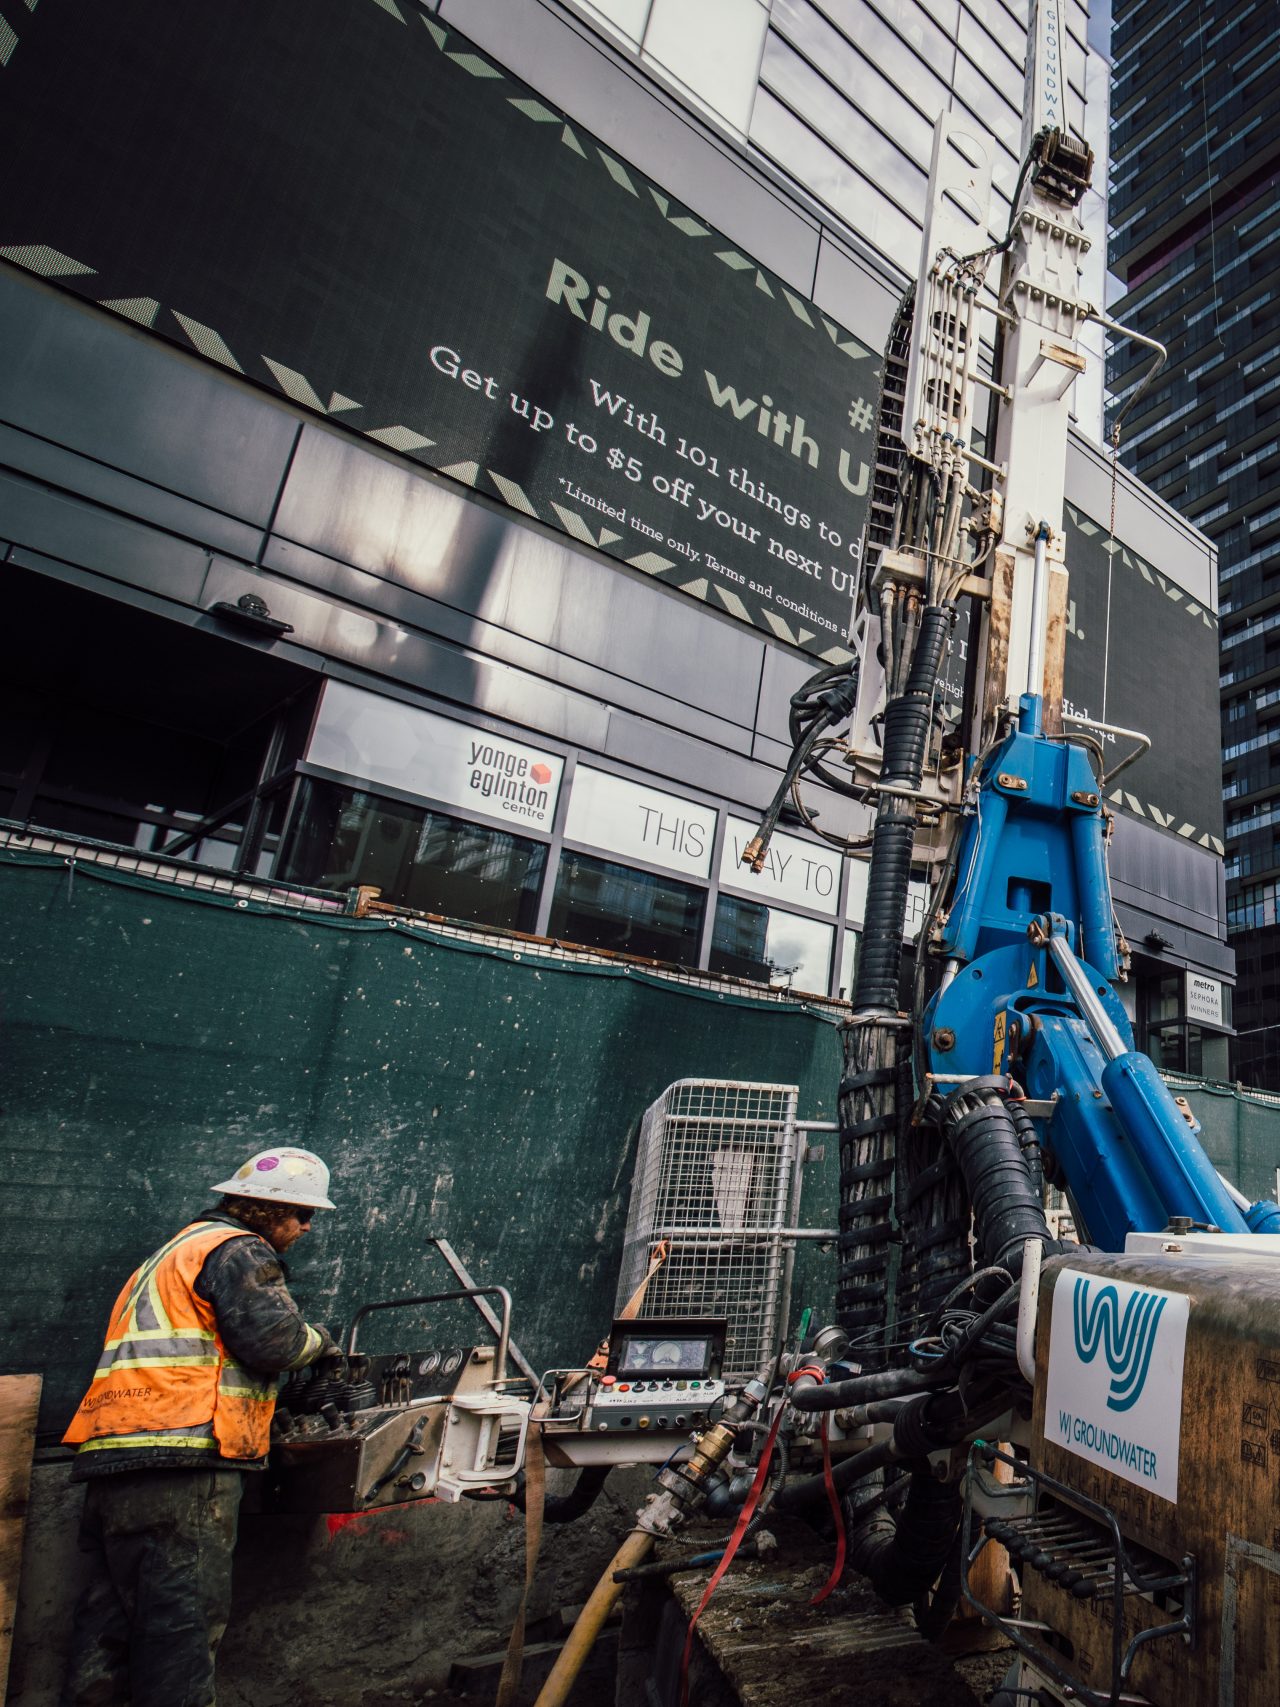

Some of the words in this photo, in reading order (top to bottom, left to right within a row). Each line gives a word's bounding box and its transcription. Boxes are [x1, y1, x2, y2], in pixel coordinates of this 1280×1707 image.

[546, 257, 684, 377] Ride
[704, 369, 819, 469] with
[839, 448, 870, 495] U
[429, 345, 499, 400] Get
[509, 391, 554, 432] up
[565, 422, 598, 453] to
[606, 447, 643, 482] $5
[652, 474, 695, 508] off
[696, 498, 761, 544] your
[767, 537, 823, 580] next
[590, 378, 667, 447] With
[676, 437, 720, 477] 101
[728, 467, 811, 530] things
[818, 521, 842, 547] to
[848, 537, 862, 559] d
[630, 516, 664, 542] time
[667, 538, 701, 562] only.
[705, 553, 746, 584] Terms
[748, 580, 772, 599] and
[775, 594, 838, 633] conditions
[467, 741, 528, 778] yonge
[470, 769, 548, 810] eglinton
[502, 801, 545, 820] centre
[639, 805, 706, 858] THIS
[802, 858, 833, 896] TO
[1190, 991, 1219, 1006] SEPHORA
[1190, 1004, 1219, 1017] WINNERS
[1194, 980, 1215, 991] metro
[1059, 1410, 1071, 1444] WJ
[1073, 1417, 1158, 1480] GROUNDWATER
